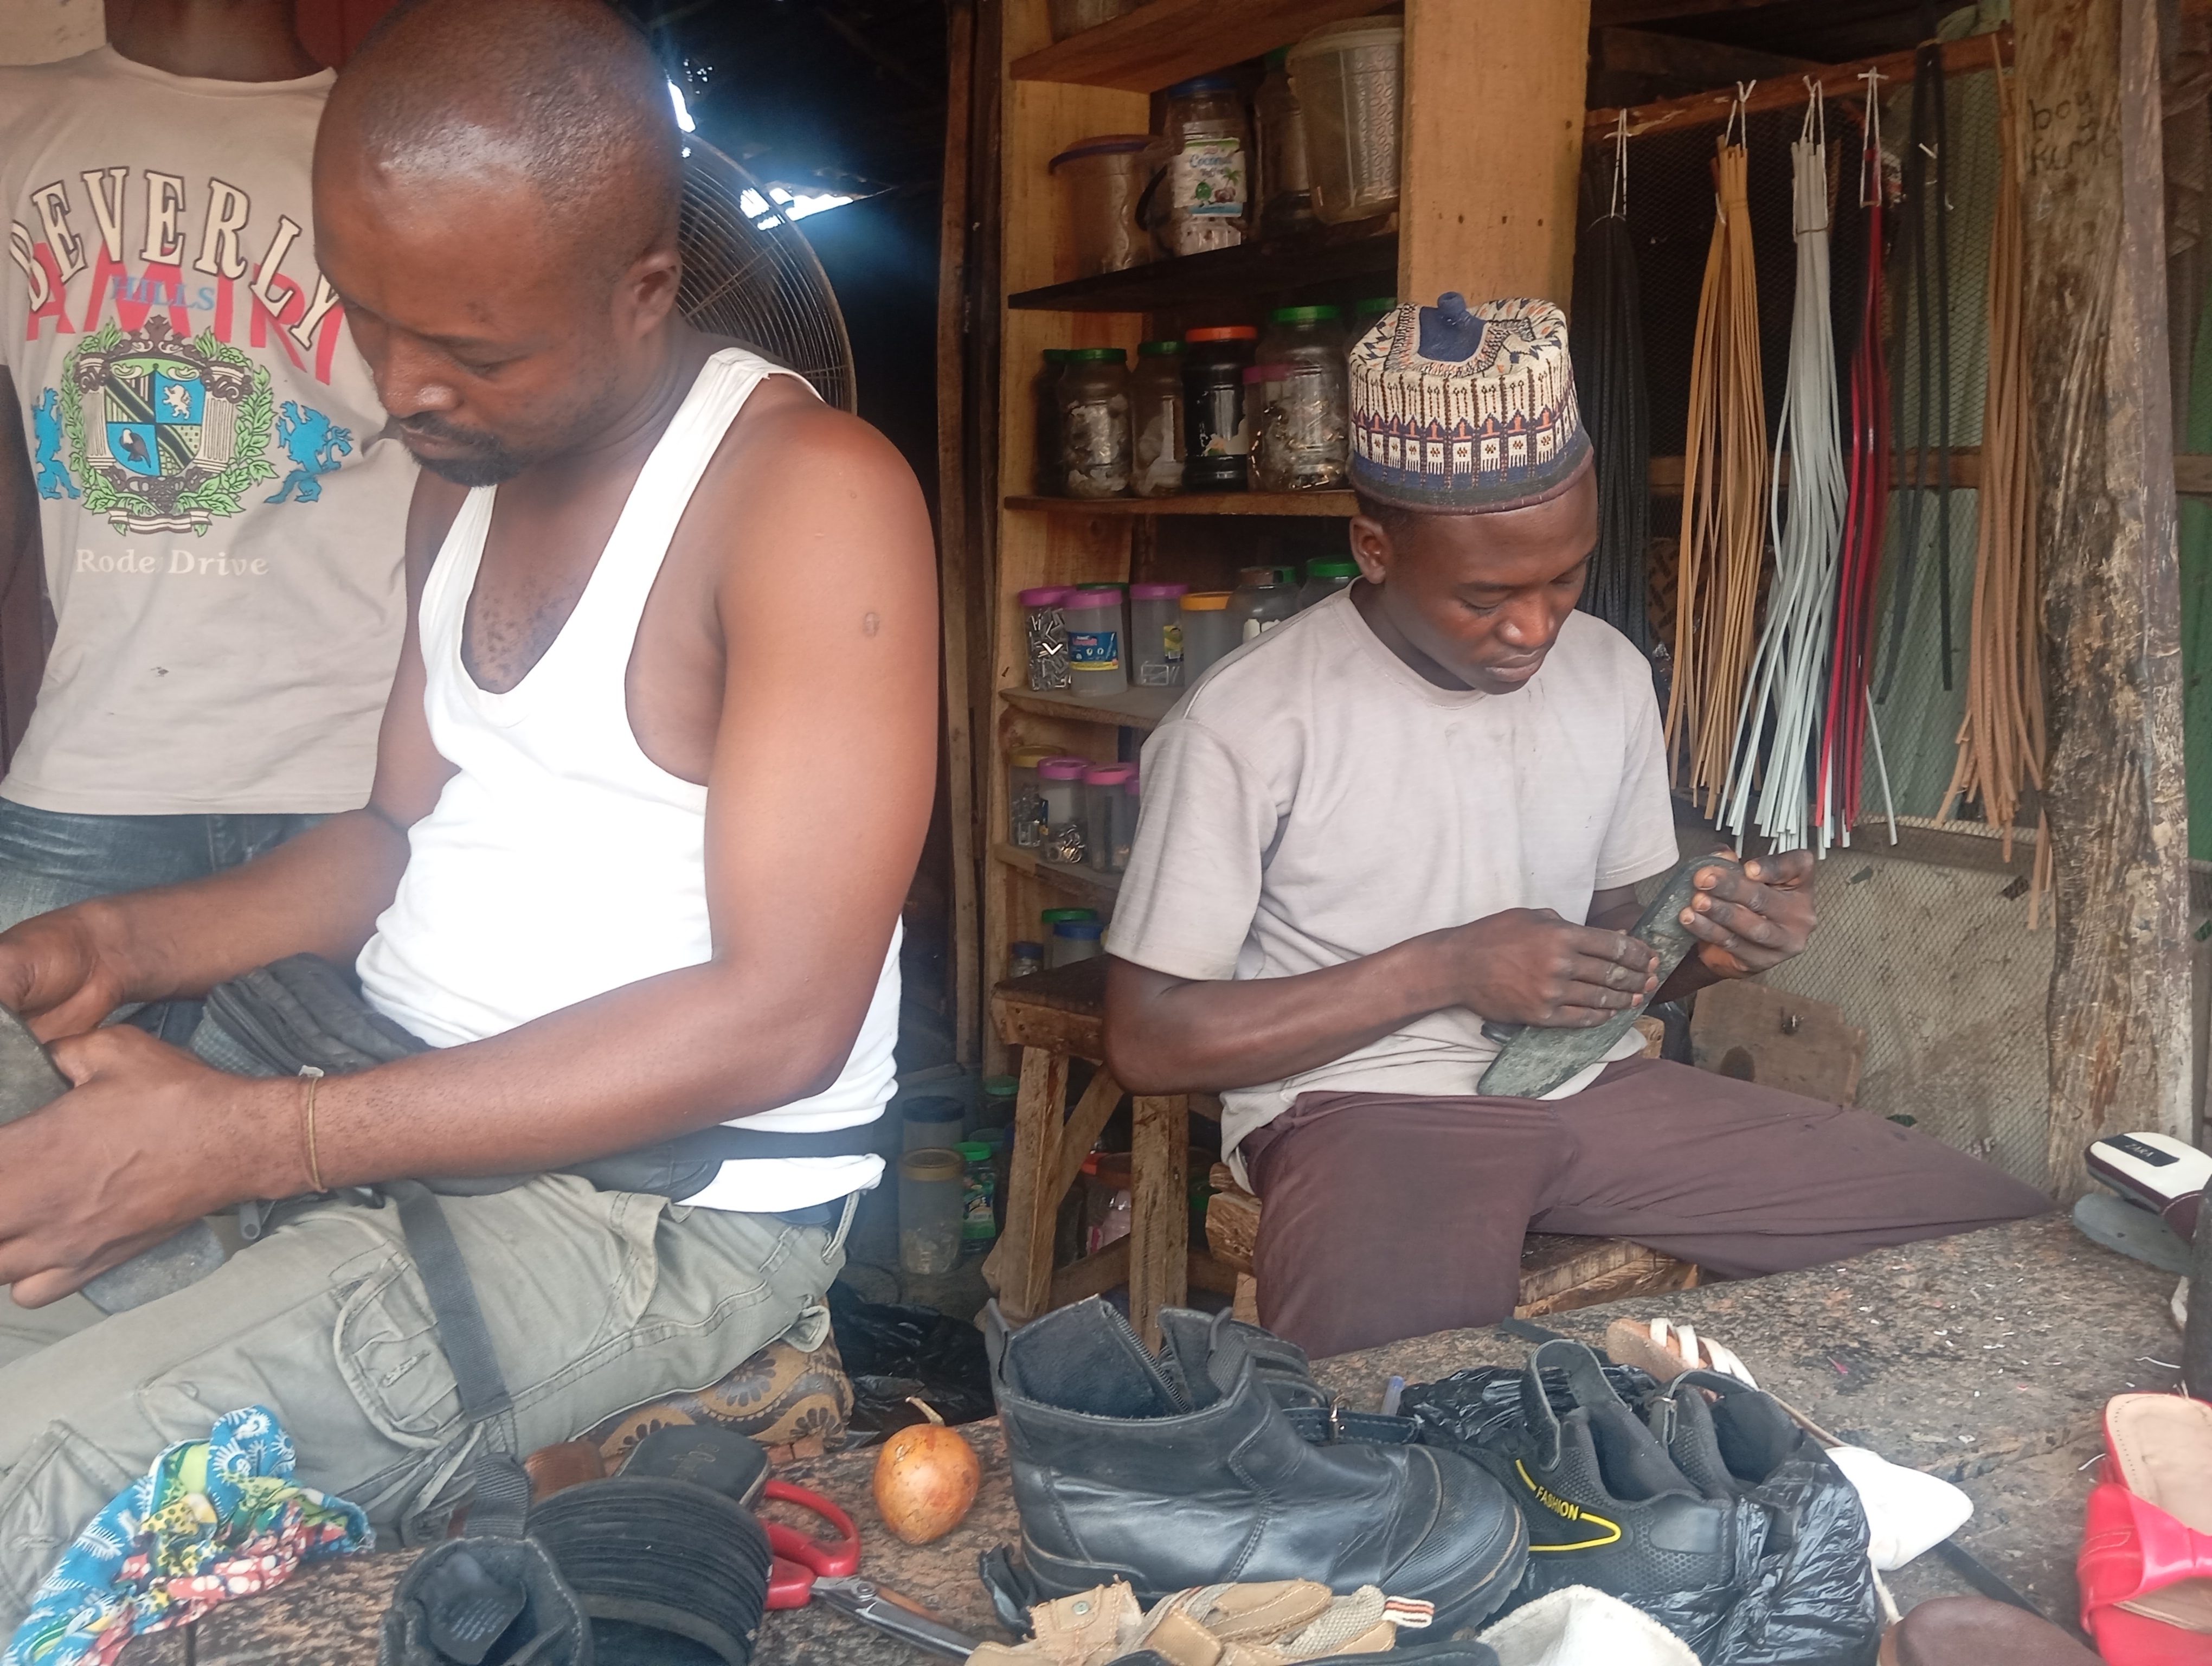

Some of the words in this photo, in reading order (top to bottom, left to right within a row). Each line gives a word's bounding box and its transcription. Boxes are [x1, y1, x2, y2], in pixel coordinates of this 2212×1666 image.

[9, 165, 340, 351] BEVERLY
[111, 276, 215, 311] HILLS
[168, 549, 269, 576] Drive
[2124, 1143, 2155, 1157] ZARA
[1535, 1485, 1579, 1521] FASHION
